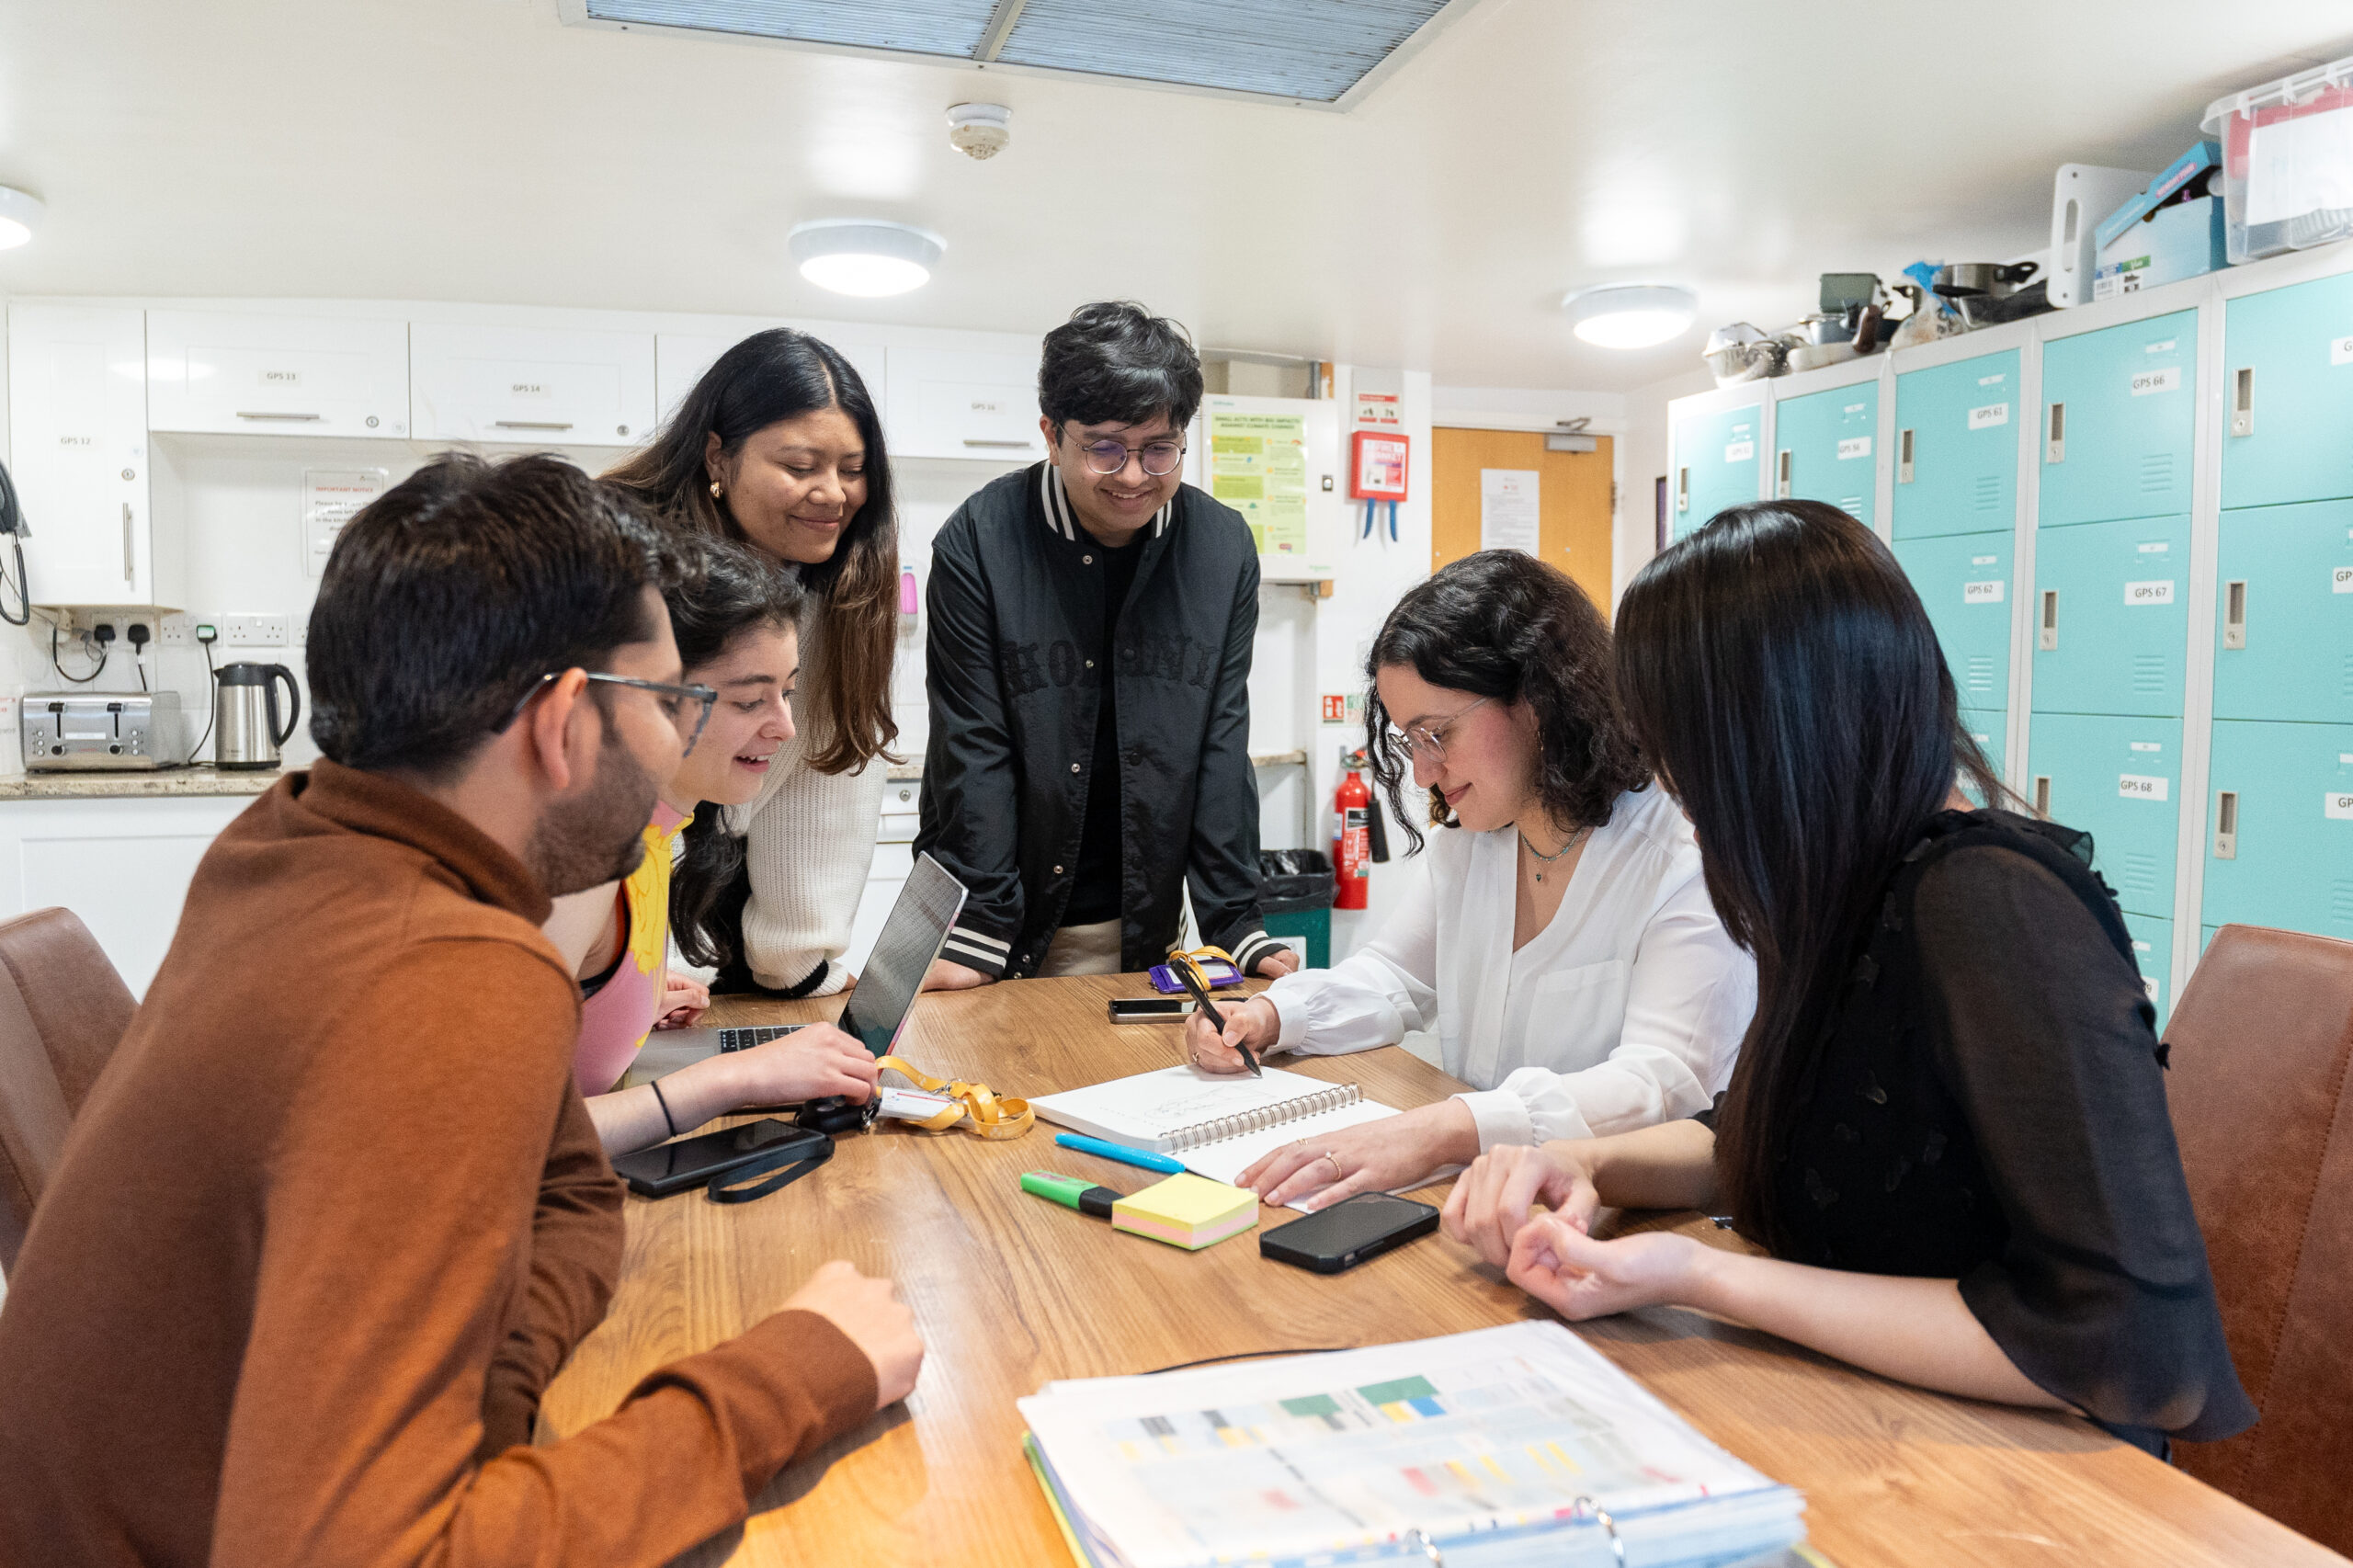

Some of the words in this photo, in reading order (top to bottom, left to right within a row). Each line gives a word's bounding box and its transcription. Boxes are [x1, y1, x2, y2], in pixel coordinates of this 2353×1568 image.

[266, 372, 283, 381] GPS
[2132, 377, 2151, 390] GPS
[2153, 374, 2165, 386] 66
[513, 384, 529, 392] GPS
[530, 385, 540, 393] 14
[1976, 410, 1993, 420] GPS
[60, 437, 78, 446] GPS
[1967, 585, 1983, 596] GPS
[1984, 584, 1994, 595] 62
[2134, 587, 2154, 598] GPS
[2154, 586, 2167, 597] 67
[2120, 779, 2139, 791] GPS
[2141, 781, 2154, 793] 68
